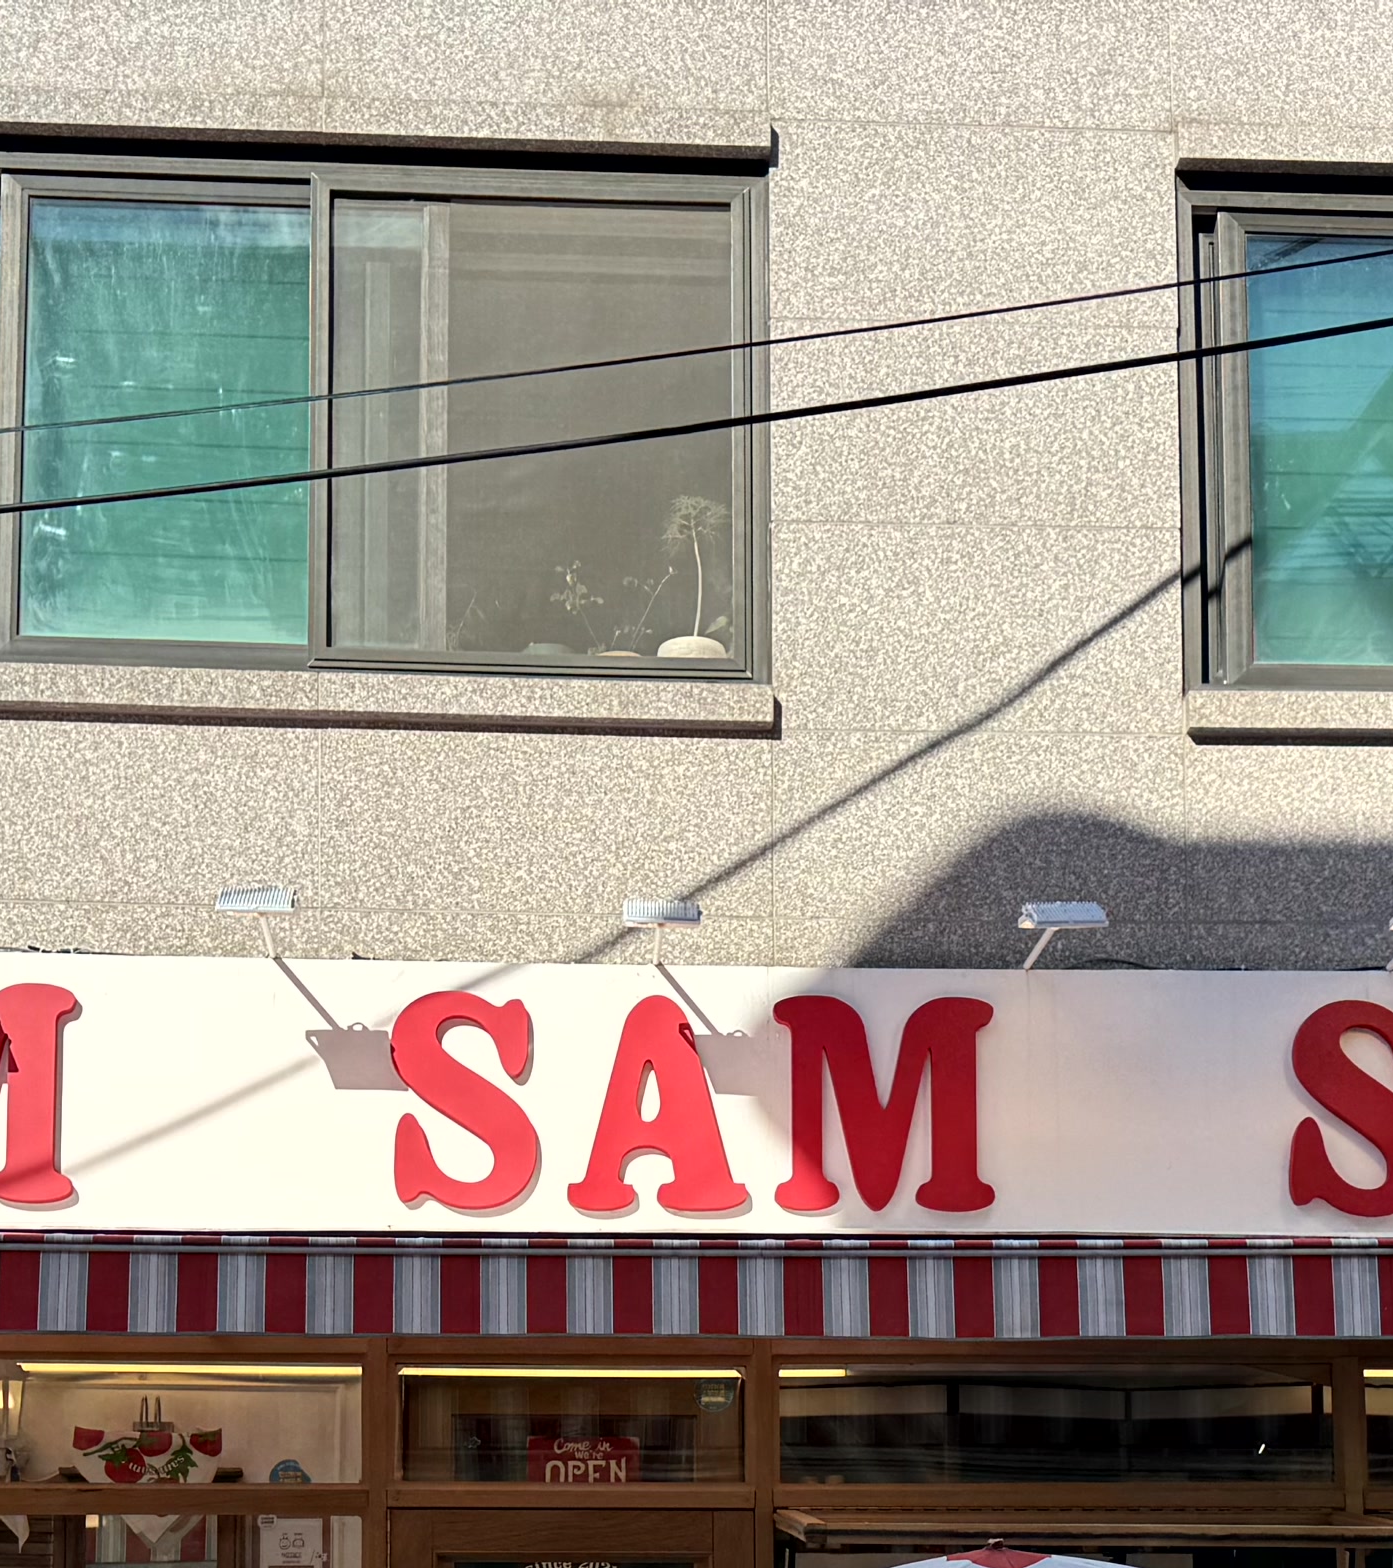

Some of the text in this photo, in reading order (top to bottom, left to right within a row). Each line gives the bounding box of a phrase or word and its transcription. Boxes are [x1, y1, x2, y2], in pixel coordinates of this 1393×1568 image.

[390, 991, 995, 1212] SAM
[553, 1438, 591, 1454] Come
[545, 1456, 627, 1483] OPEN
